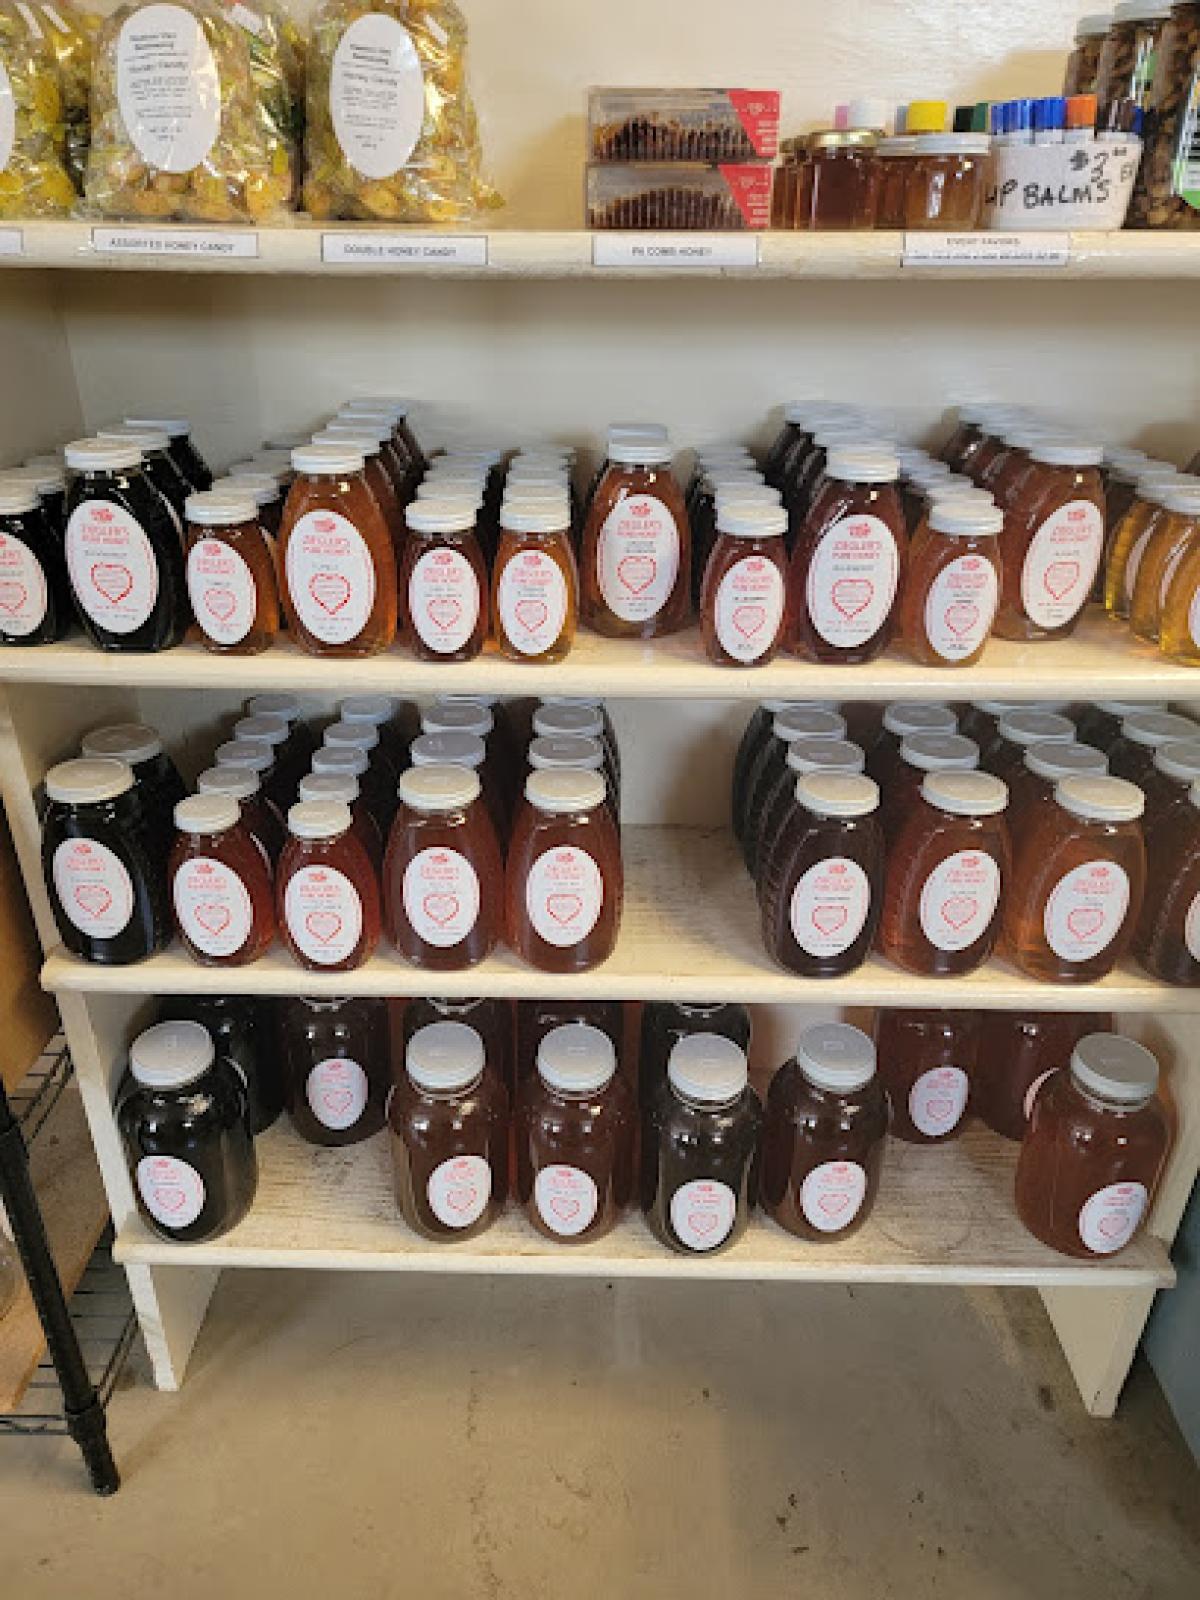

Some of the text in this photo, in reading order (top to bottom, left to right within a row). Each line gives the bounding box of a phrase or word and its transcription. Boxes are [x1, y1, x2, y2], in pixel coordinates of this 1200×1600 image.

[1023, 178, 1110, 209] BALMS
[164, 241, 198, 251] HONEY
[199, 241, 233, 252] CANDY
[343, 243, 457, 257] DOUBLE HONEY CANDY
[646, 246, 677, 257] COMB
[678, 246, 713, 257] HONEY
